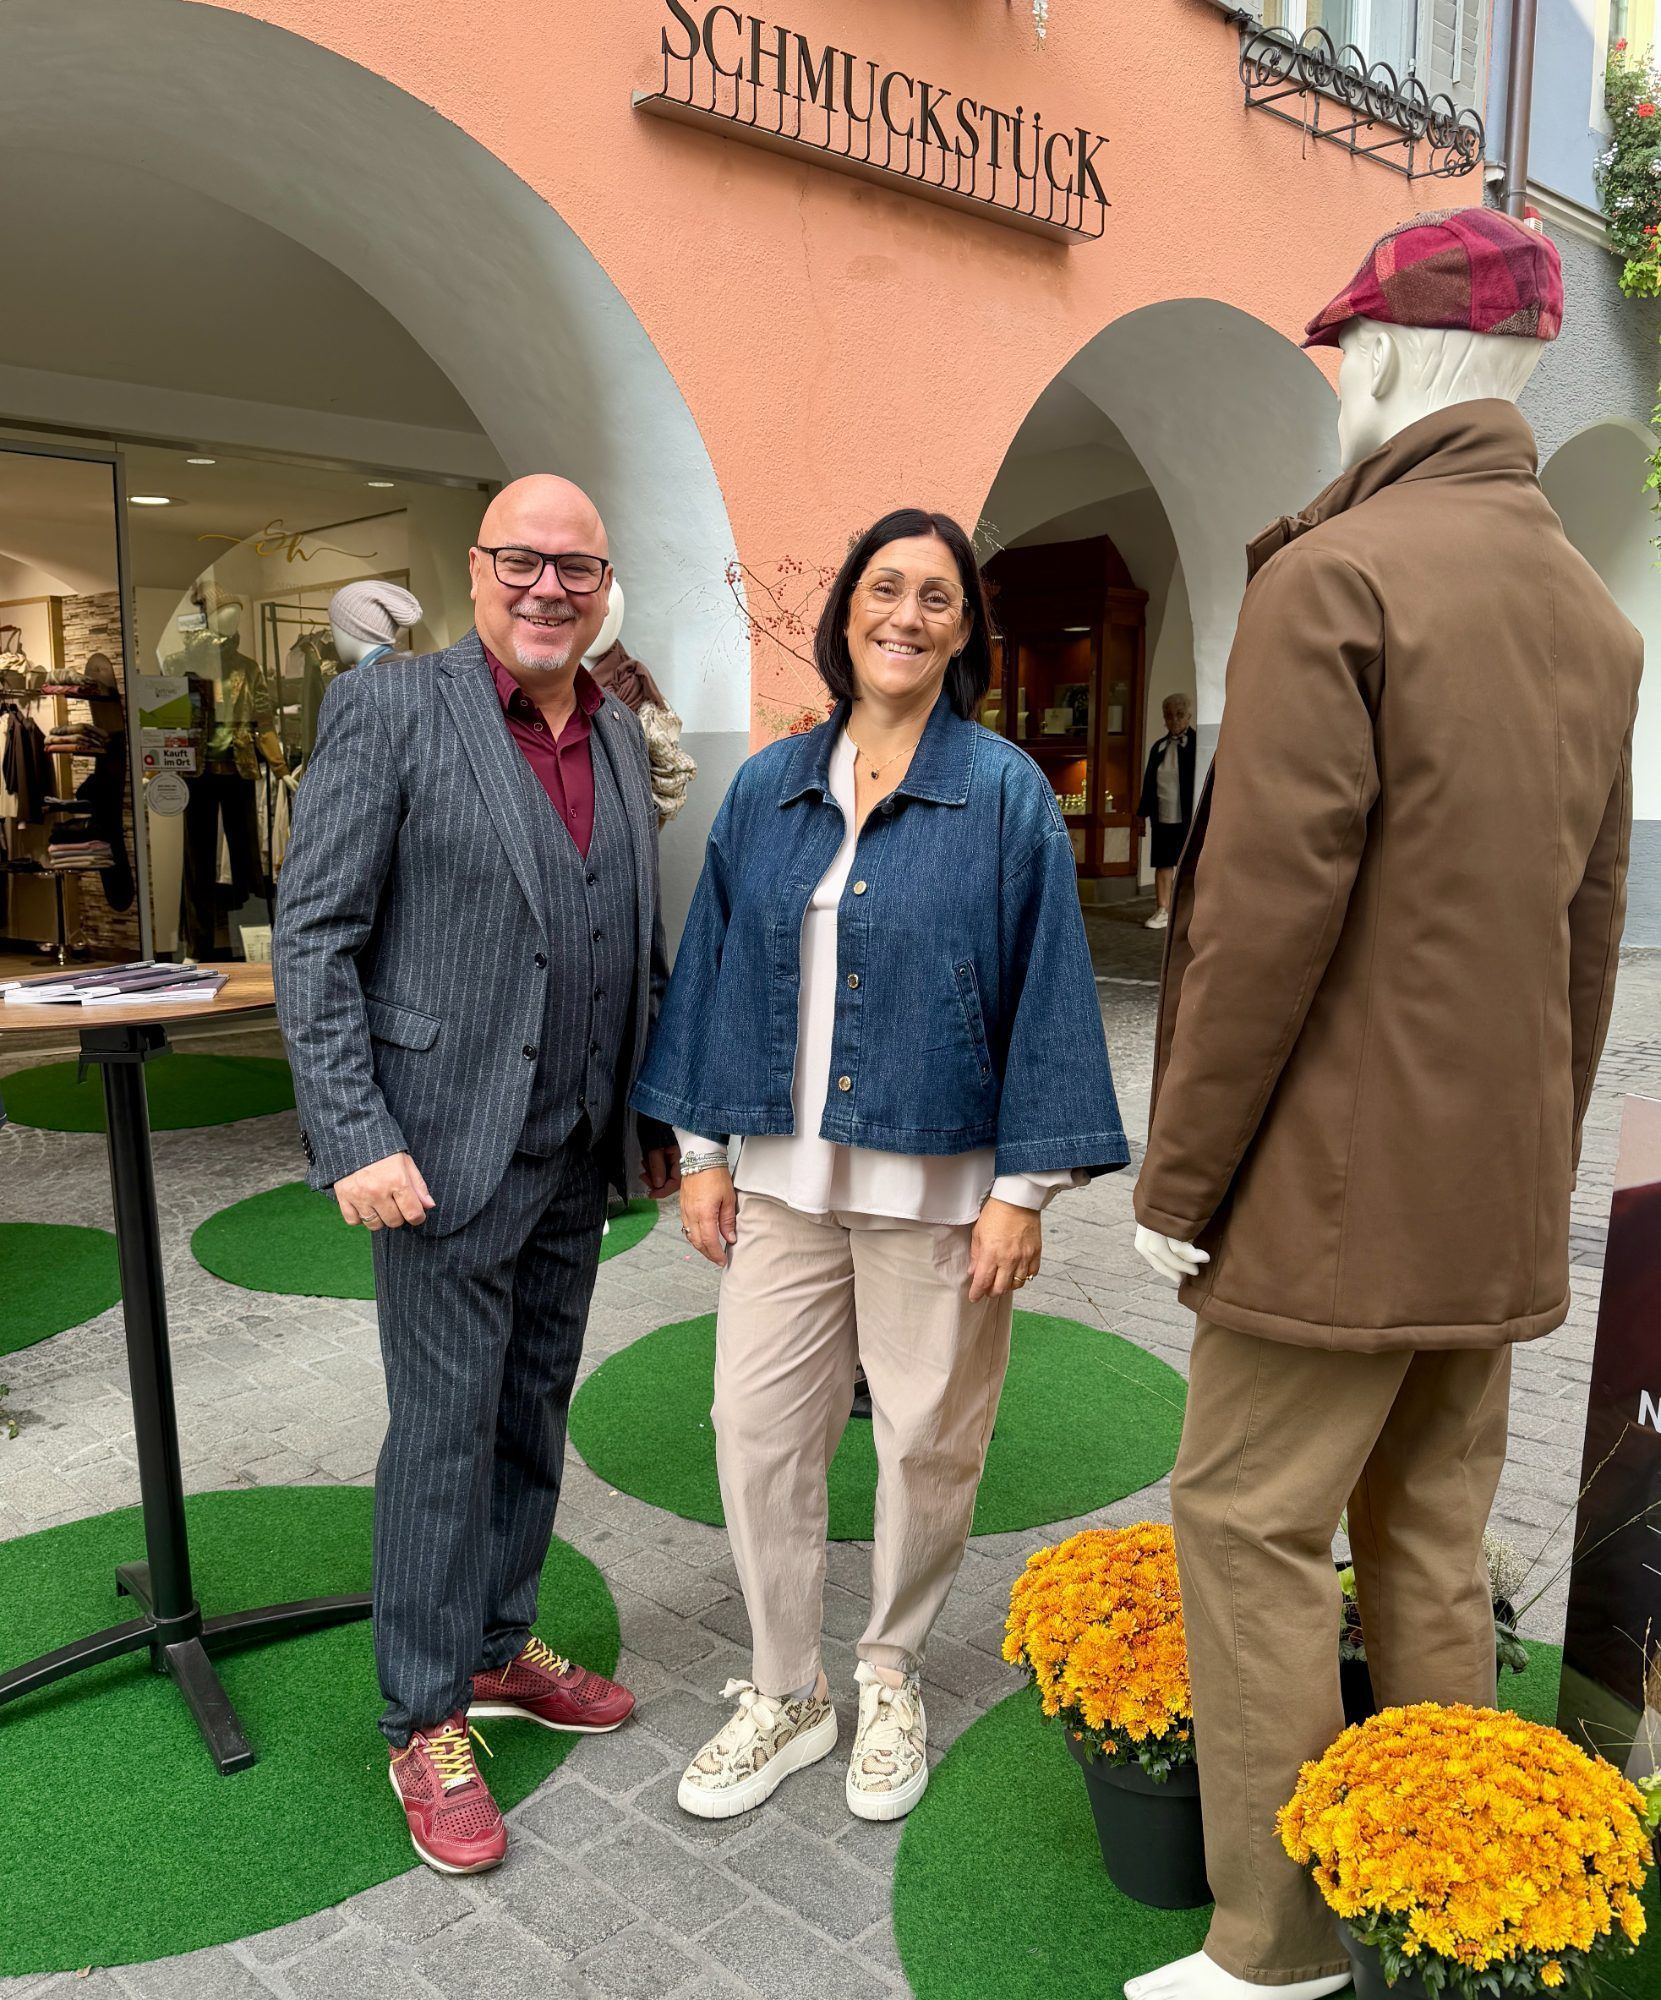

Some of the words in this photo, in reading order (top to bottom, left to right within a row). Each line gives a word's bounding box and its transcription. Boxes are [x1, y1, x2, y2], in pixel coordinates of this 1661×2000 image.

[662, 0, 1111, 206] SCHMUCKSTÜCK
[163, 750, 188, 758] Kauft
[164, 758, 175, 766] im
[176, 758, 191, 766] Ort
